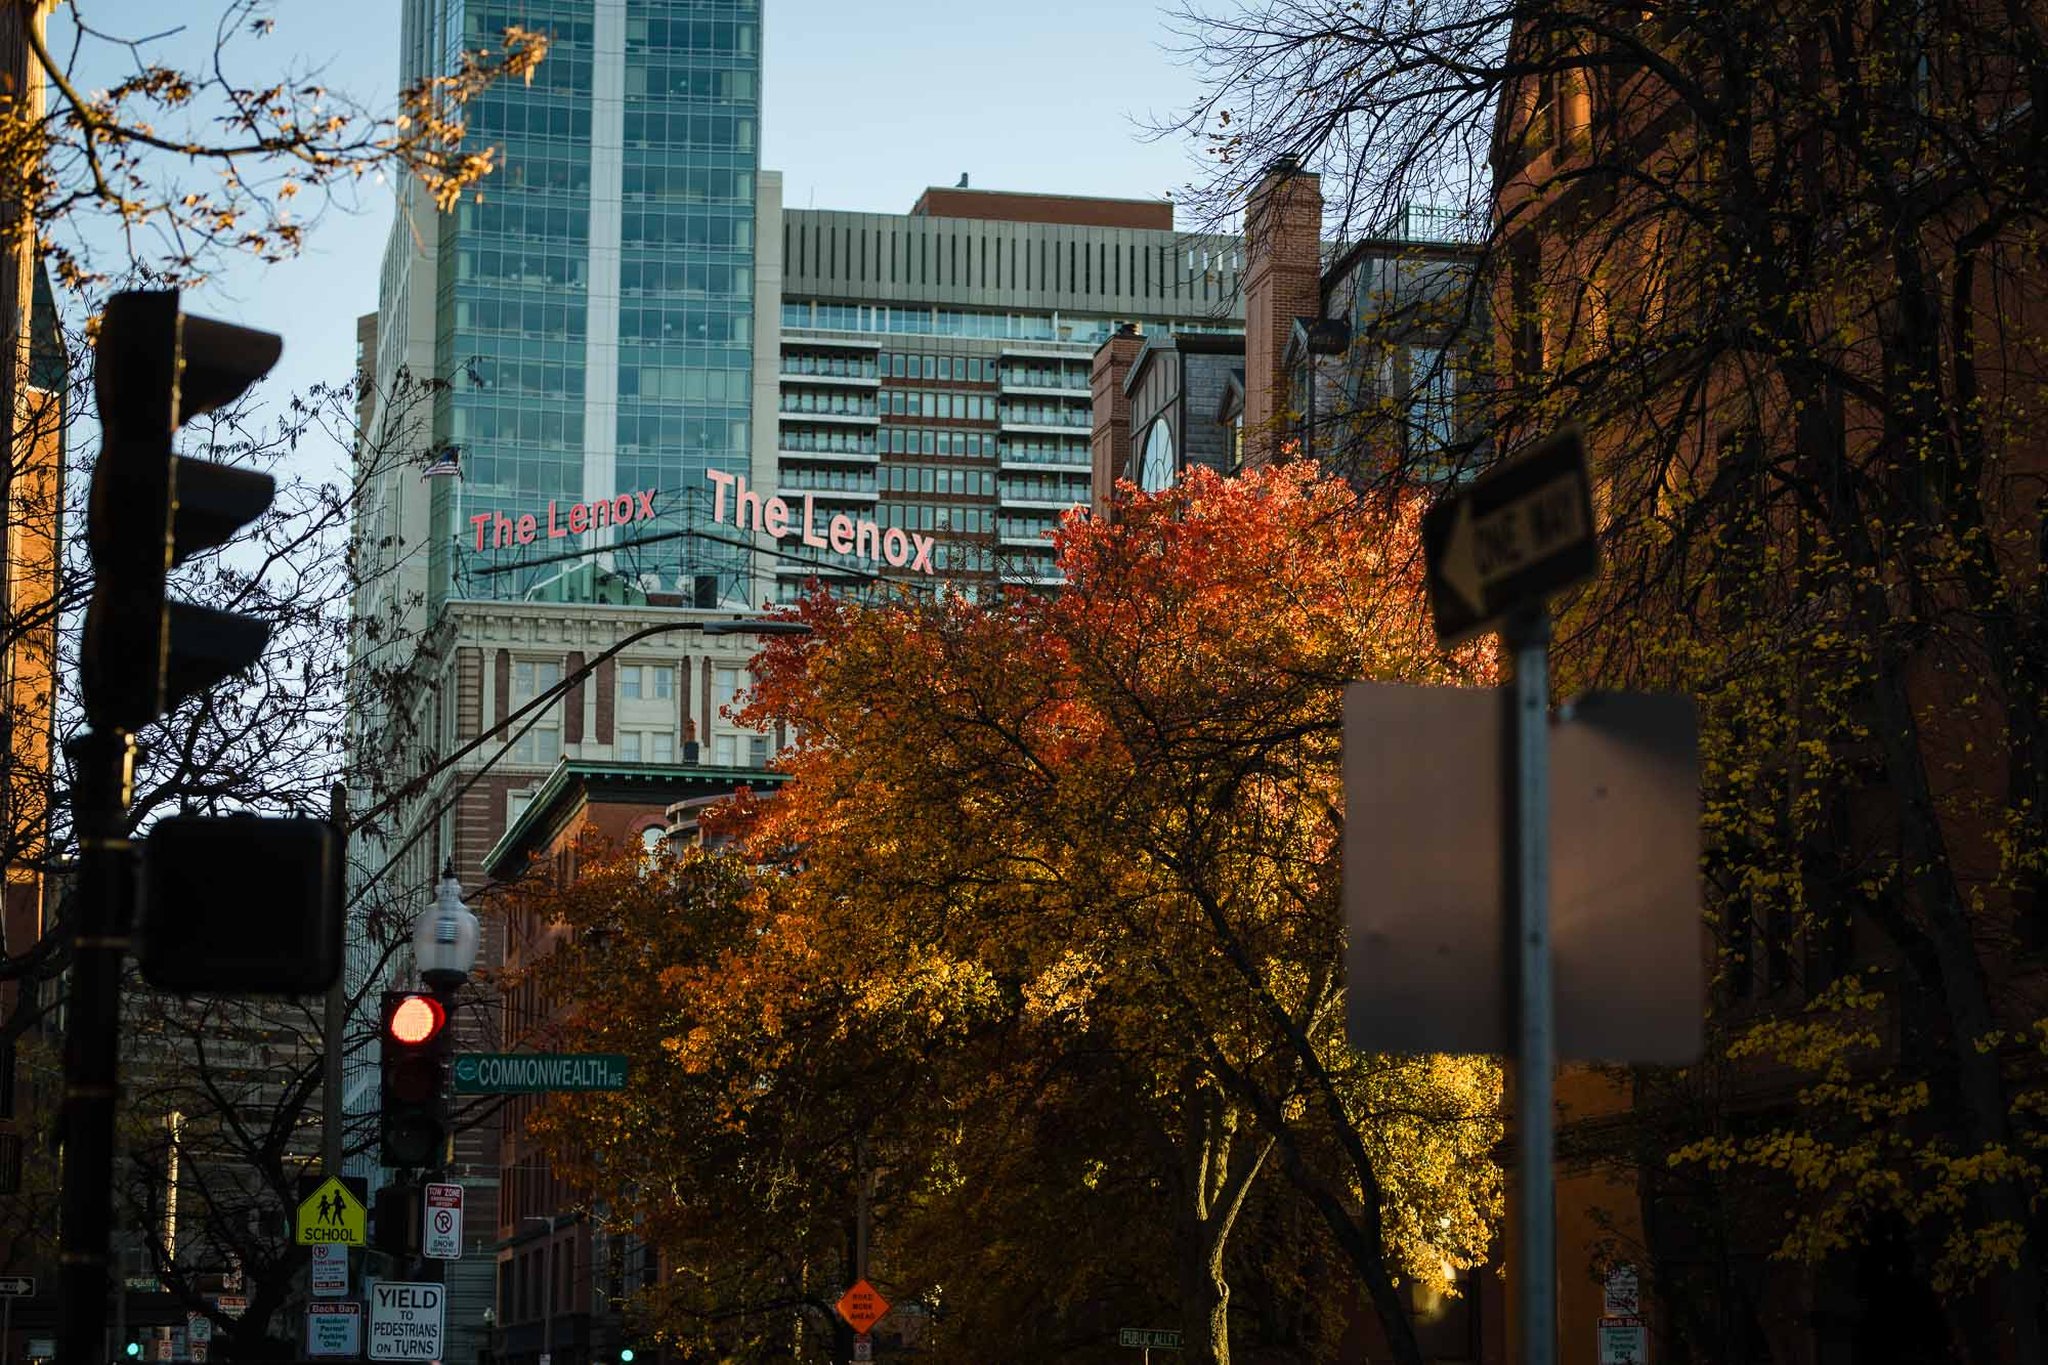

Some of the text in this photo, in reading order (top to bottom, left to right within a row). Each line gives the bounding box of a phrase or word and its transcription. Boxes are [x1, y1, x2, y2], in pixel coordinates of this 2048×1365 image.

[469, 487, 659, 553] The Lenox
[706, 467, 936, 576] The Lenox
[478, 1058, 608, 1087] COMMONWEALTH
[609, 1073, 624, 1087] AVE
[444, 1187, 460, 1197] ZONE
[304, 1228, 357, 1242] SCHOOL
[378, 1288, 438, 1309] YIELD
[312, 1304, 356, 1314] Back Bay
[401, 1310, 414, 1321] TO
[374, 1322, 438, 1338] PEDESTRIANS
[1123, 1331, 1150, 1345] PUBLIC
[376, 1339, 434, 1355] ON TURNS
